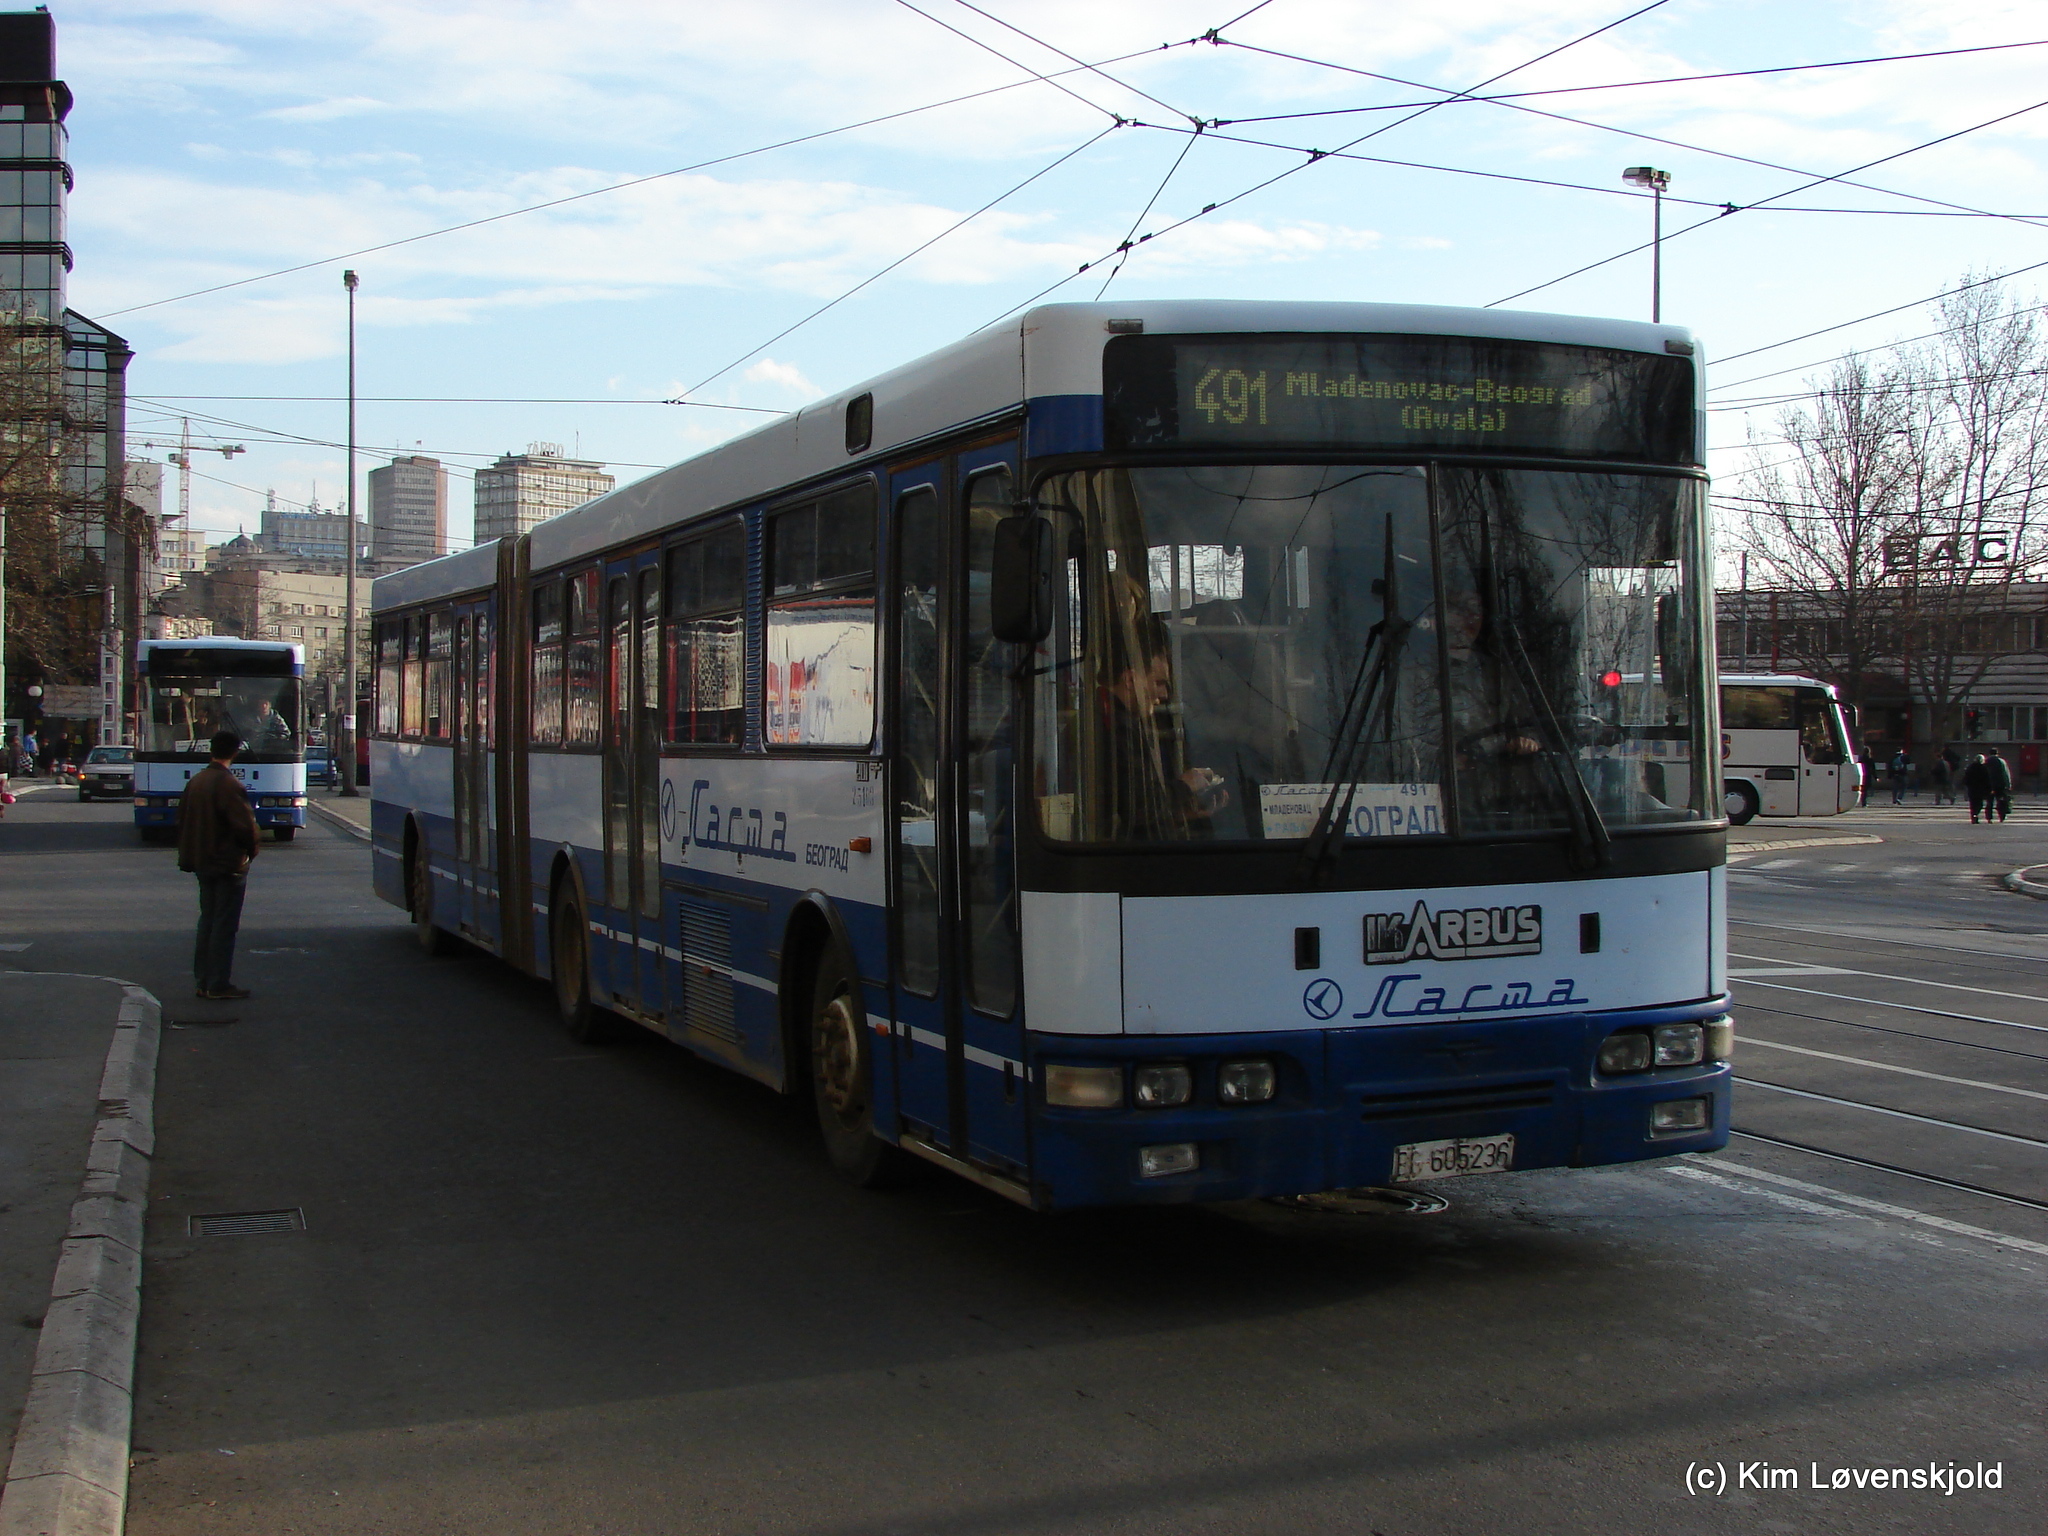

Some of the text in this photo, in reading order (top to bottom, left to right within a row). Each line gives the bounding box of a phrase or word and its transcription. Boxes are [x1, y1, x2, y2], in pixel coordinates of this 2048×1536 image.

[1195, 368, 1592, 425] 491 Mladenovac-Beograd
[1402, 405, 1506, 432] (Avala)
[1401, 784, 1427, 796] 491
[682, 779, 796, 862] Ласта
[805, 843, 848, 873] БЕОГРАД
[1365, 900, 1541, 963] IKARBUS
[1352, 973, 1589, 1019] Ласта
